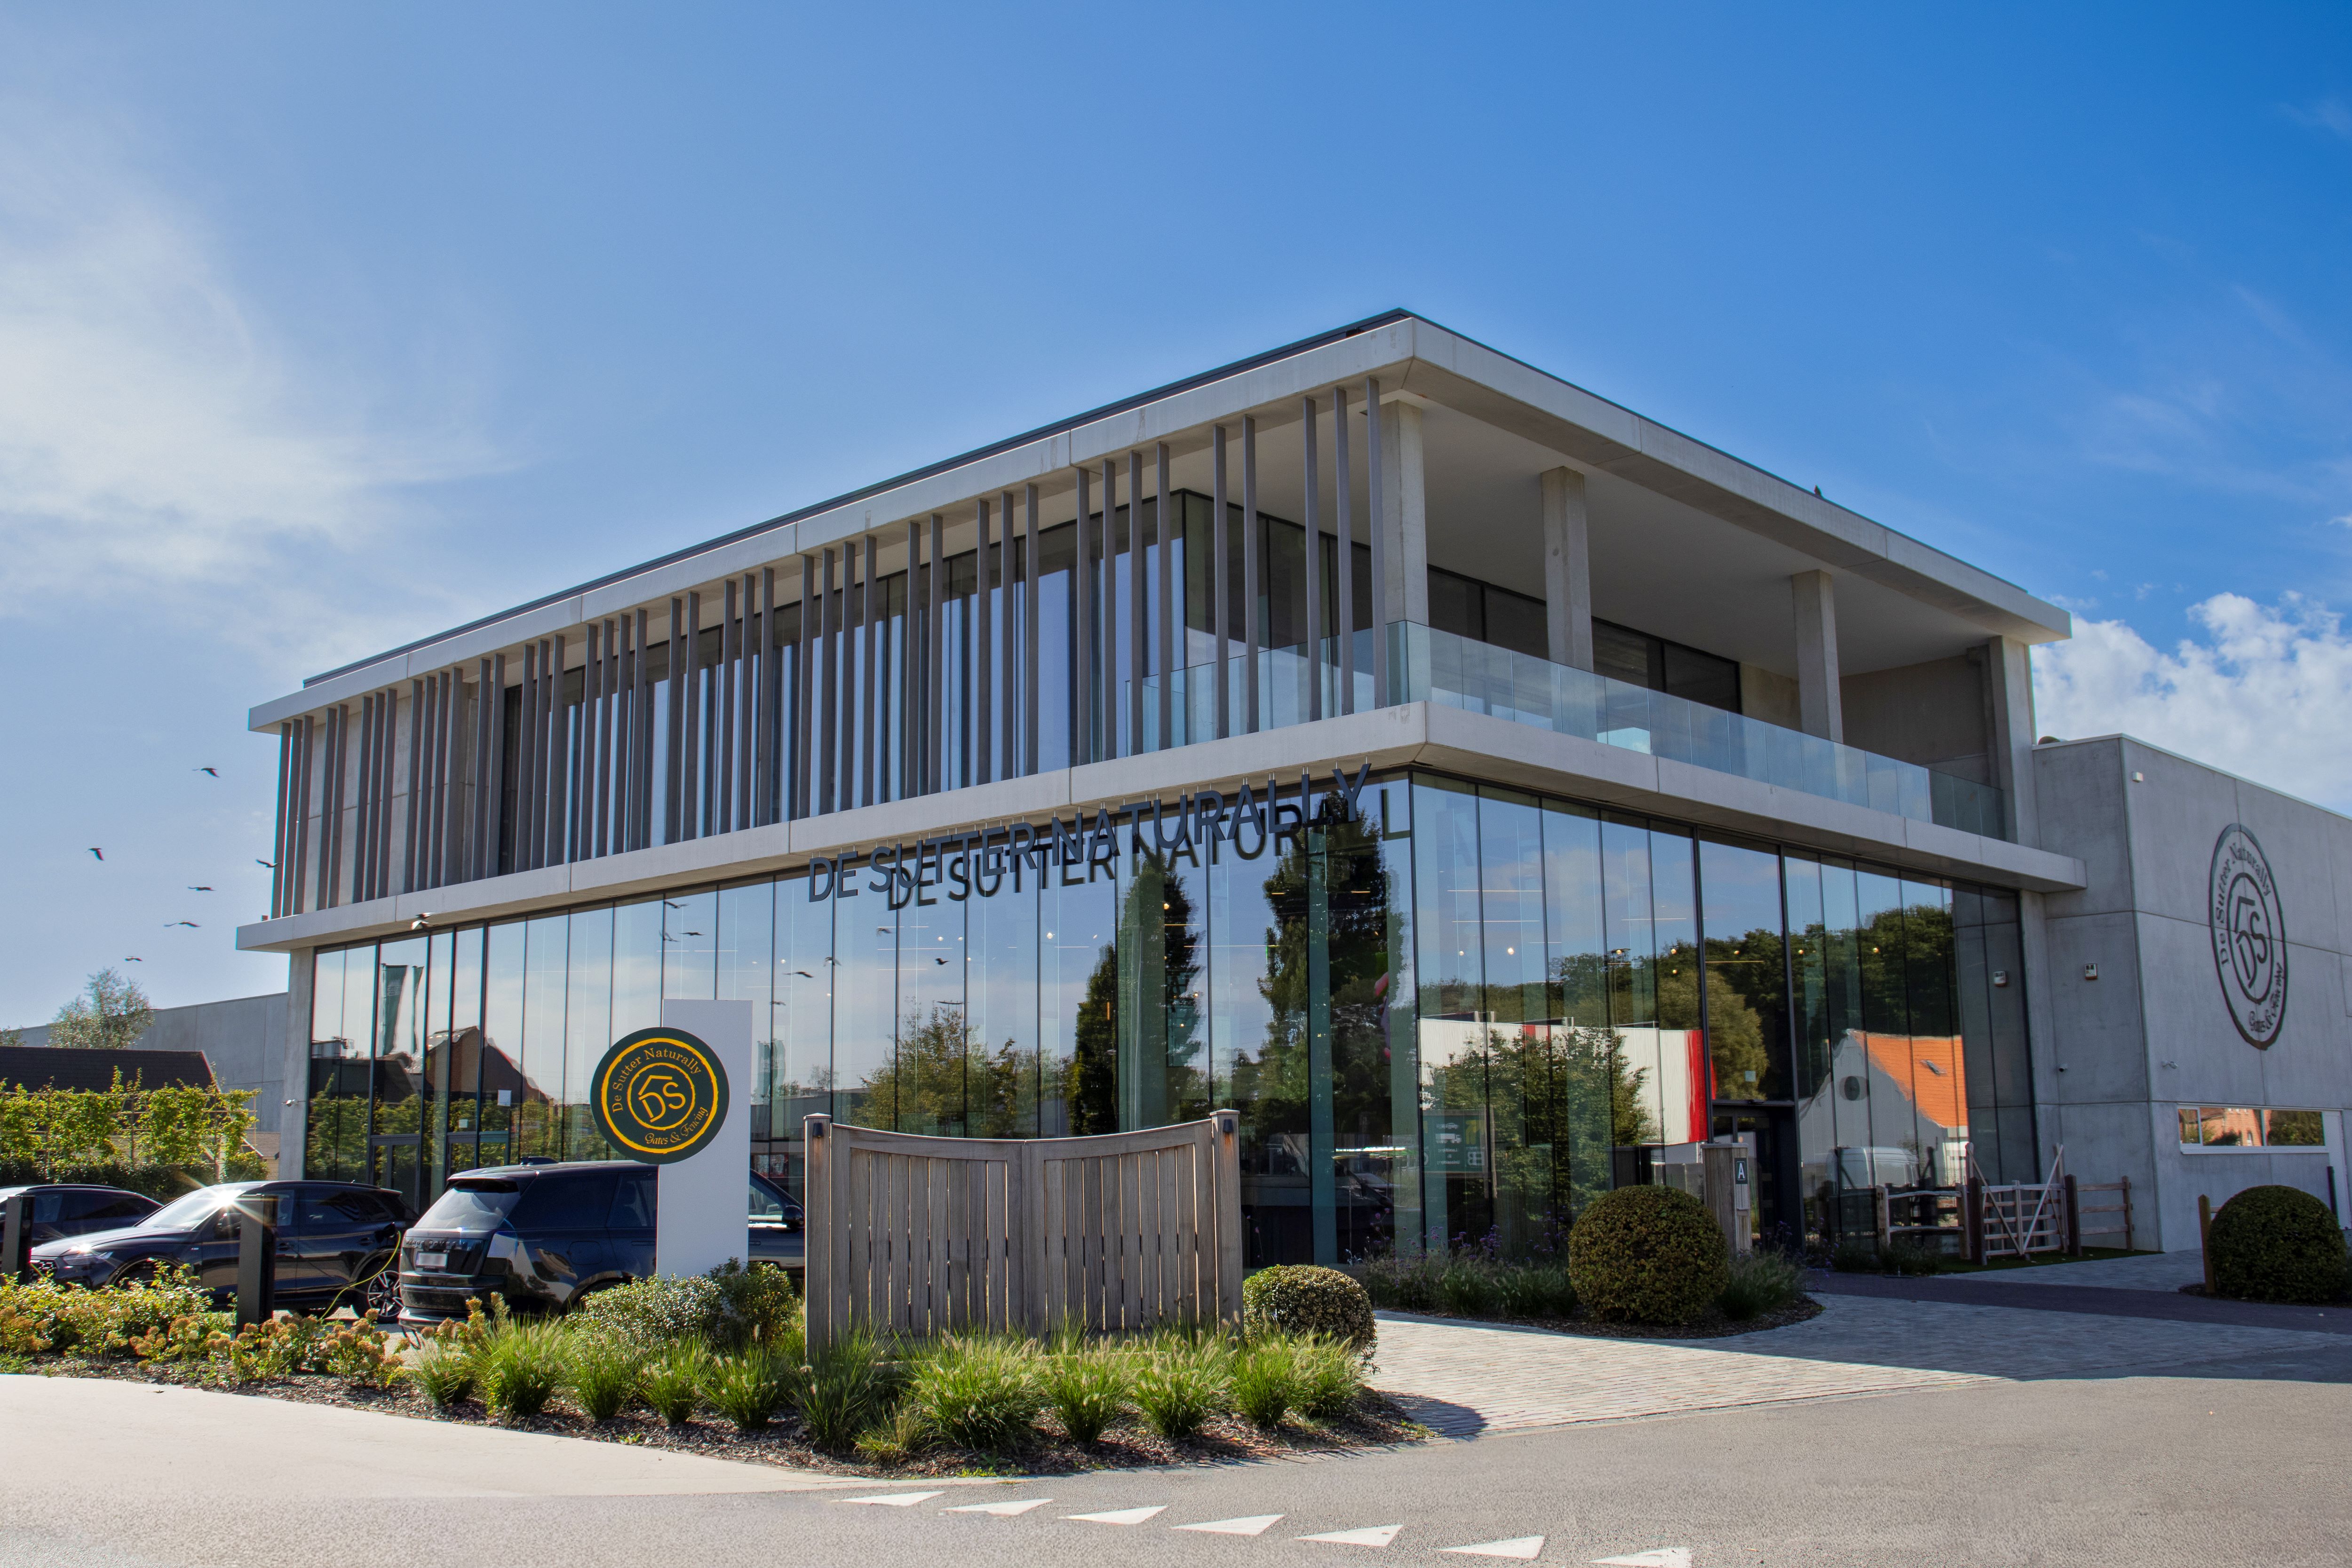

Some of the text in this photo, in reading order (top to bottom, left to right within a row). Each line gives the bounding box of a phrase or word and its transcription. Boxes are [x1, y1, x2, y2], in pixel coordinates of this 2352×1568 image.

[809, 763, 1372, 902] DE SUTTER NATURALLY
[2216, 842, 2272, 967] De Sutter Naturally
[612, 1047, 702, 1113] De Sutter Naturally
[644, 1106, 709, 1145] Gates & Fencing
[1738, 1162, 1745, 1179] A
